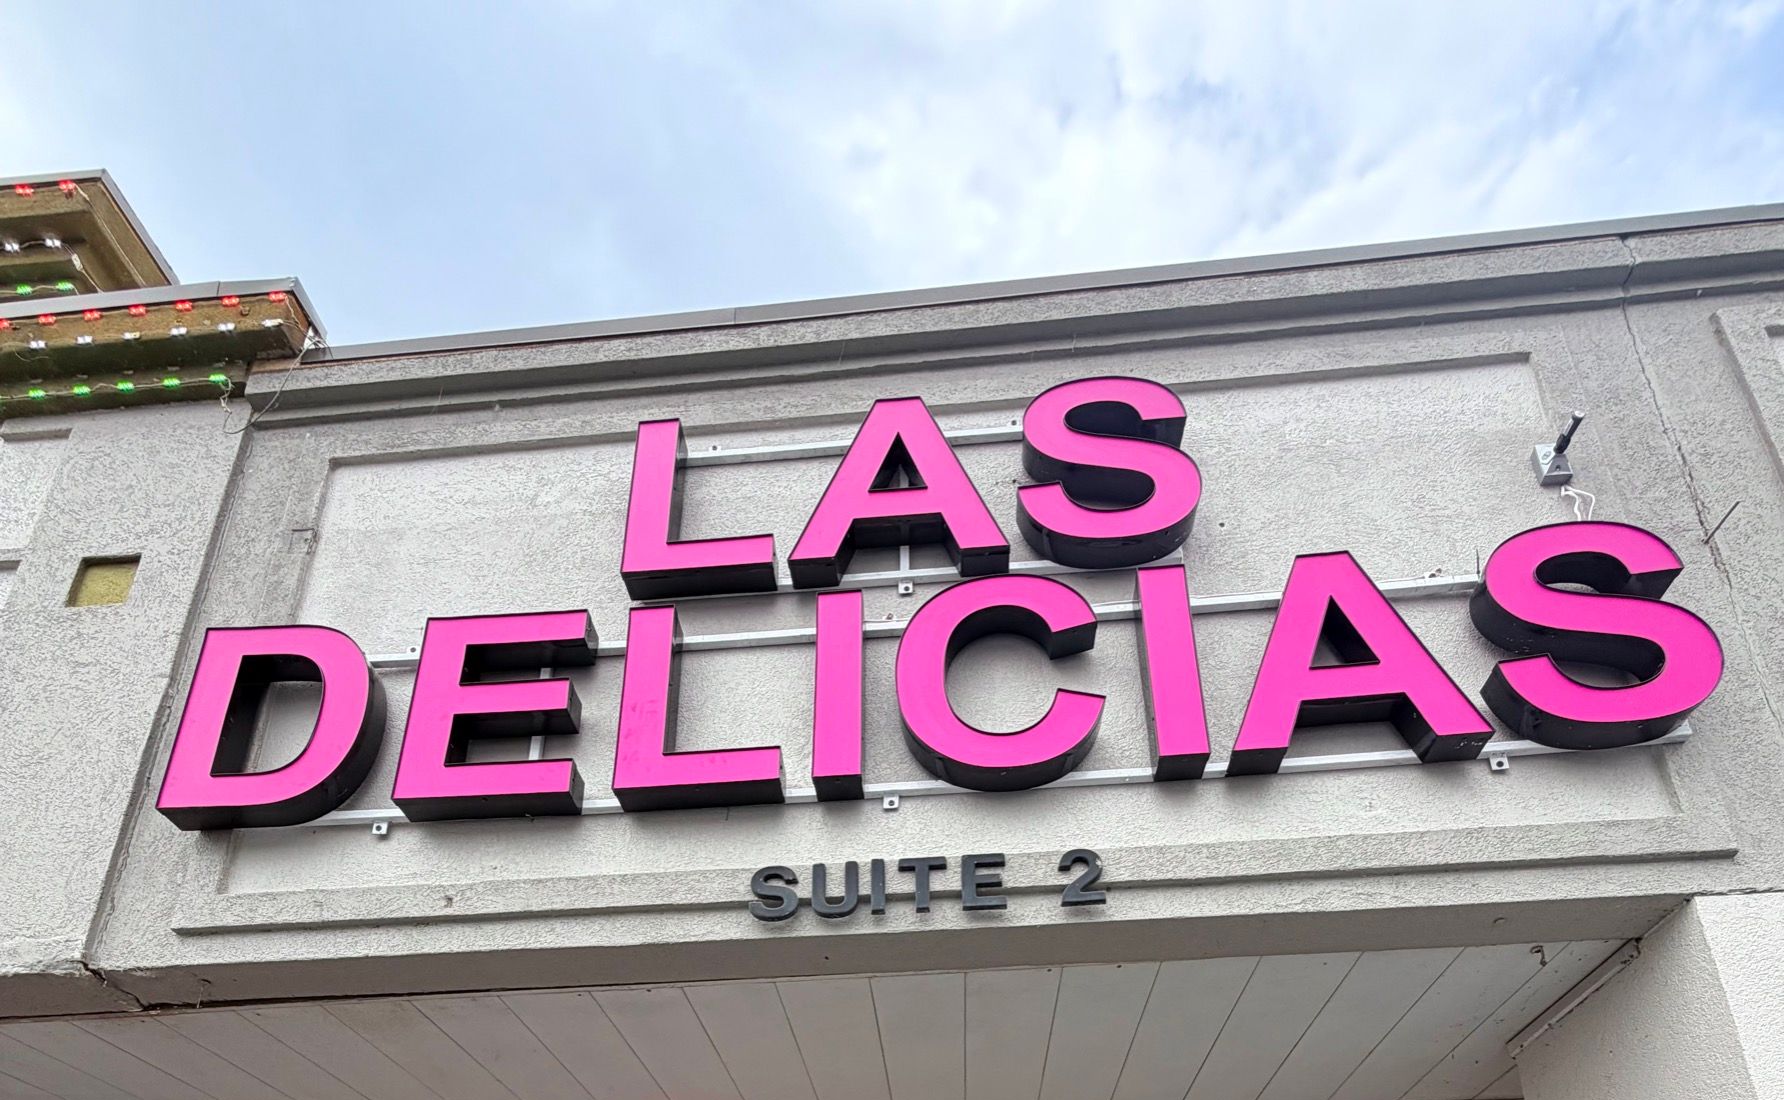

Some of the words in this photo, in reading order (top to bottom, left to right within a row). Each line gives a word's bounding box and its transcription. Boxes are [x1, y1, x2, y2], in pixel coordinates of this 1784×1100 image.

[621, 376, 1202, 600] LAS
[157, 520, 1724, 830] DELICIAS
[748, 853, 1007, 922] SUITE
[1058, 849, 1106, 907] 2
